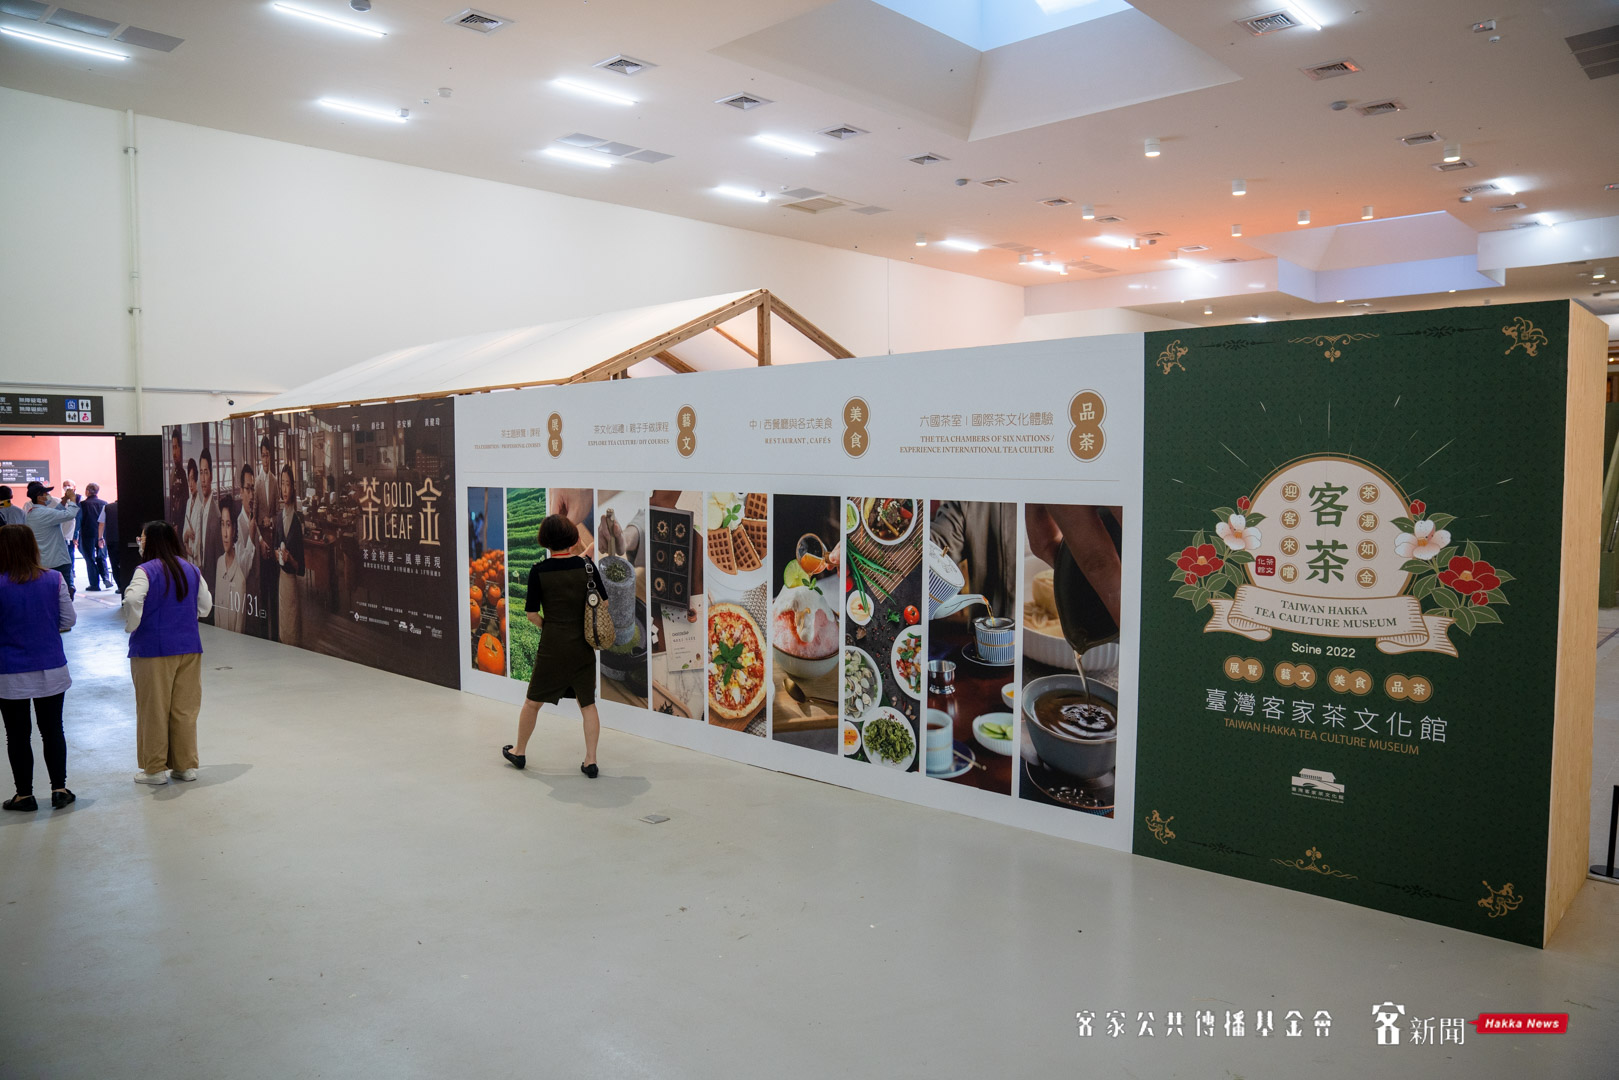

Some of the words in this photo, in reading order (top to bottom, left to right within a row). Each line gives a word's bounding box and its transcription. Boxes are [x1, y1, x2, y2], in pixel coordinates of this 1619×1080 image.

[850, 406, 863, 448] 美食
[920, 414, 962, 427] 六國茶室
[971, 411, 1054, 427] 國際茶文化體驗
[1078, 402, 1096, 452] 品茶
[920, 435, 935, 443] THE
[936, 435, 949, 443] TEA
[950, 435, 990, 443] CHAMBERS
[1003, 434, 1015, 442] SIX
[1016, 434, 1050, 442] NATIONS
[942, 446, 1001, 454] INTERNATIONAL
[1003, 446, 1018, 454] TEA
[1019, 446, 1055, 454] CULTURE
[384, 482, 413, 508] GOLD
[359, 477, 381, 541] 茶
[416, 477, 442, 546] 金
[385, 513, 413, 540] LEAF
[1305, 482, 1349, 584] 客茶
[1360, 486, 1376, 584] 茶湯如金
[1254, 606, 1276, 619] TEA
[1279, 612, 1340, 628] CAULTURE
[1343, 617, 1397, 628] MUSEUM
[1281, 600, 1325, 614] TAIWAN
[1328, 606, 1368, 615] HAKKA
[1291, 642, 1322, 655] Scine
[1326, 645, 1356, 658] 2022
[1229, 662, 1258, 676] 展覽
[1280, 668, 1311, 682] 藝文
[1334, 674, 1367, 689] 美食
[1391, 681, 1426, 696] 品茶
[1205, 688, 1448, 743] 臺灣客家茶文化館
[1224, 717, 1261, 732] TAIWAN
[1263, 724, 1297, 737] HAKKA
[1299, 729, 1318, 741] TEA
[1320, 732, 1367, 748] CULTURE
[1369, 739, 1419, 755] MUSEUM
